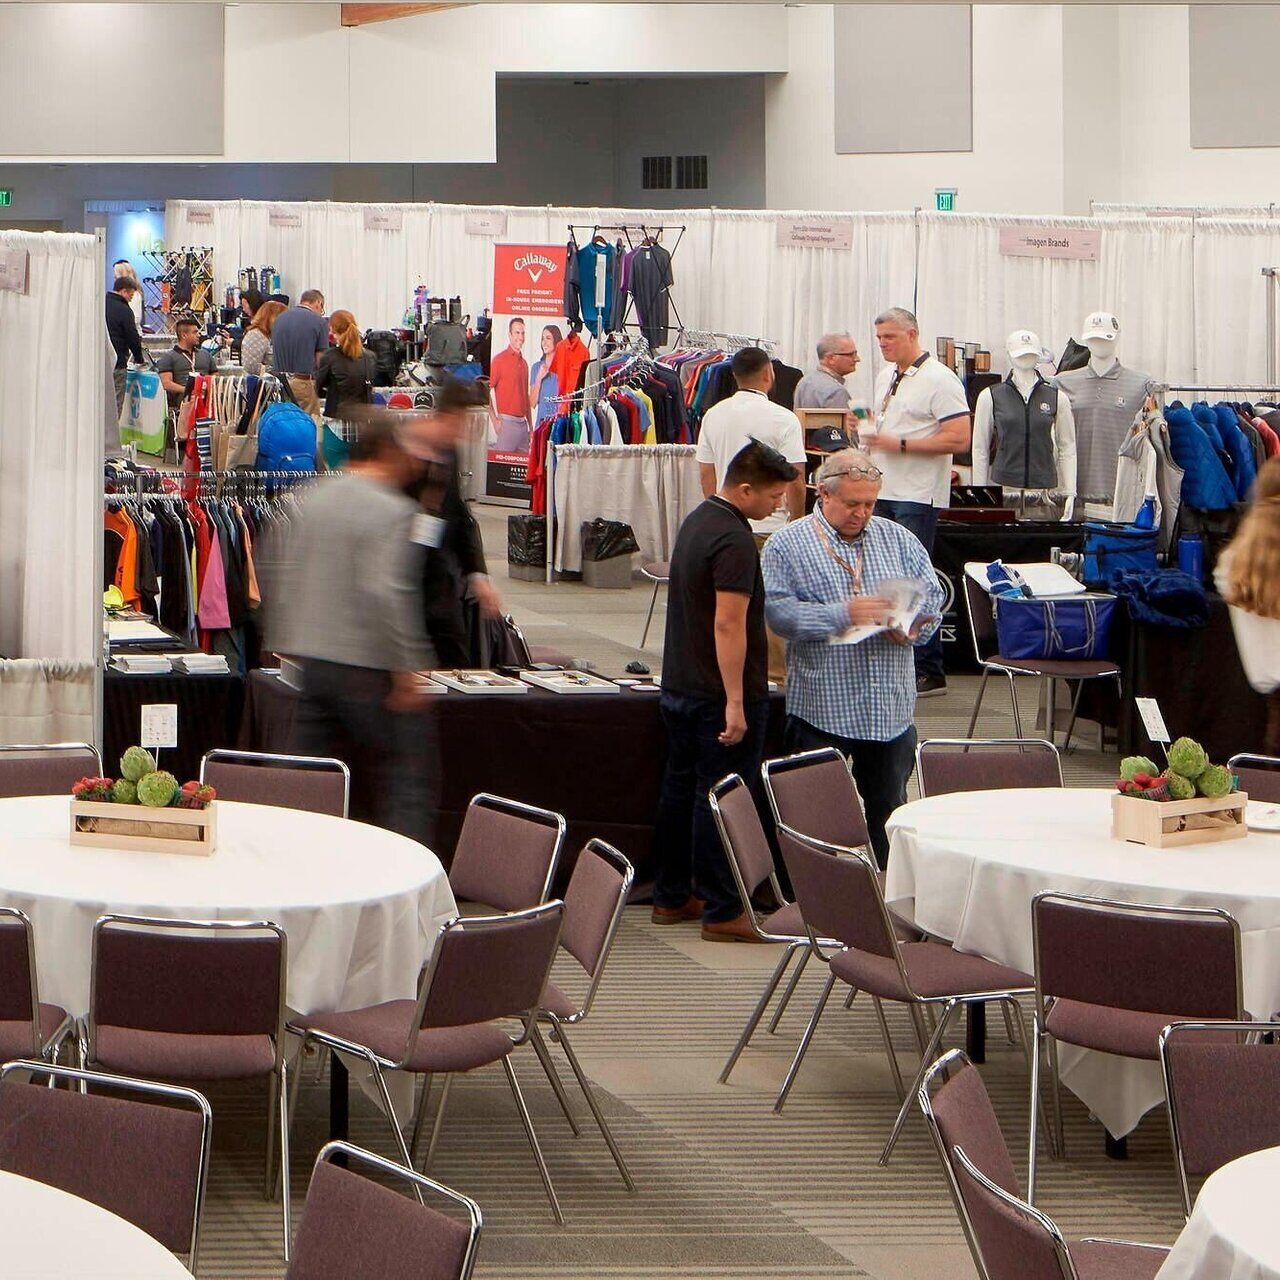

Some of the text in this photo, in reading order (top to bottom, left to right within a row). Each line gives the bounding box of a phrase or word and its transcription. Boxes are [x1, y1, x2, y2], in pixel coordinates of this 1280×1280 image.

[939, 193, 952, 211] EXIT
[1048, 237, 1070, 248] Brands
[514, 252, 558, 273] Callaway
